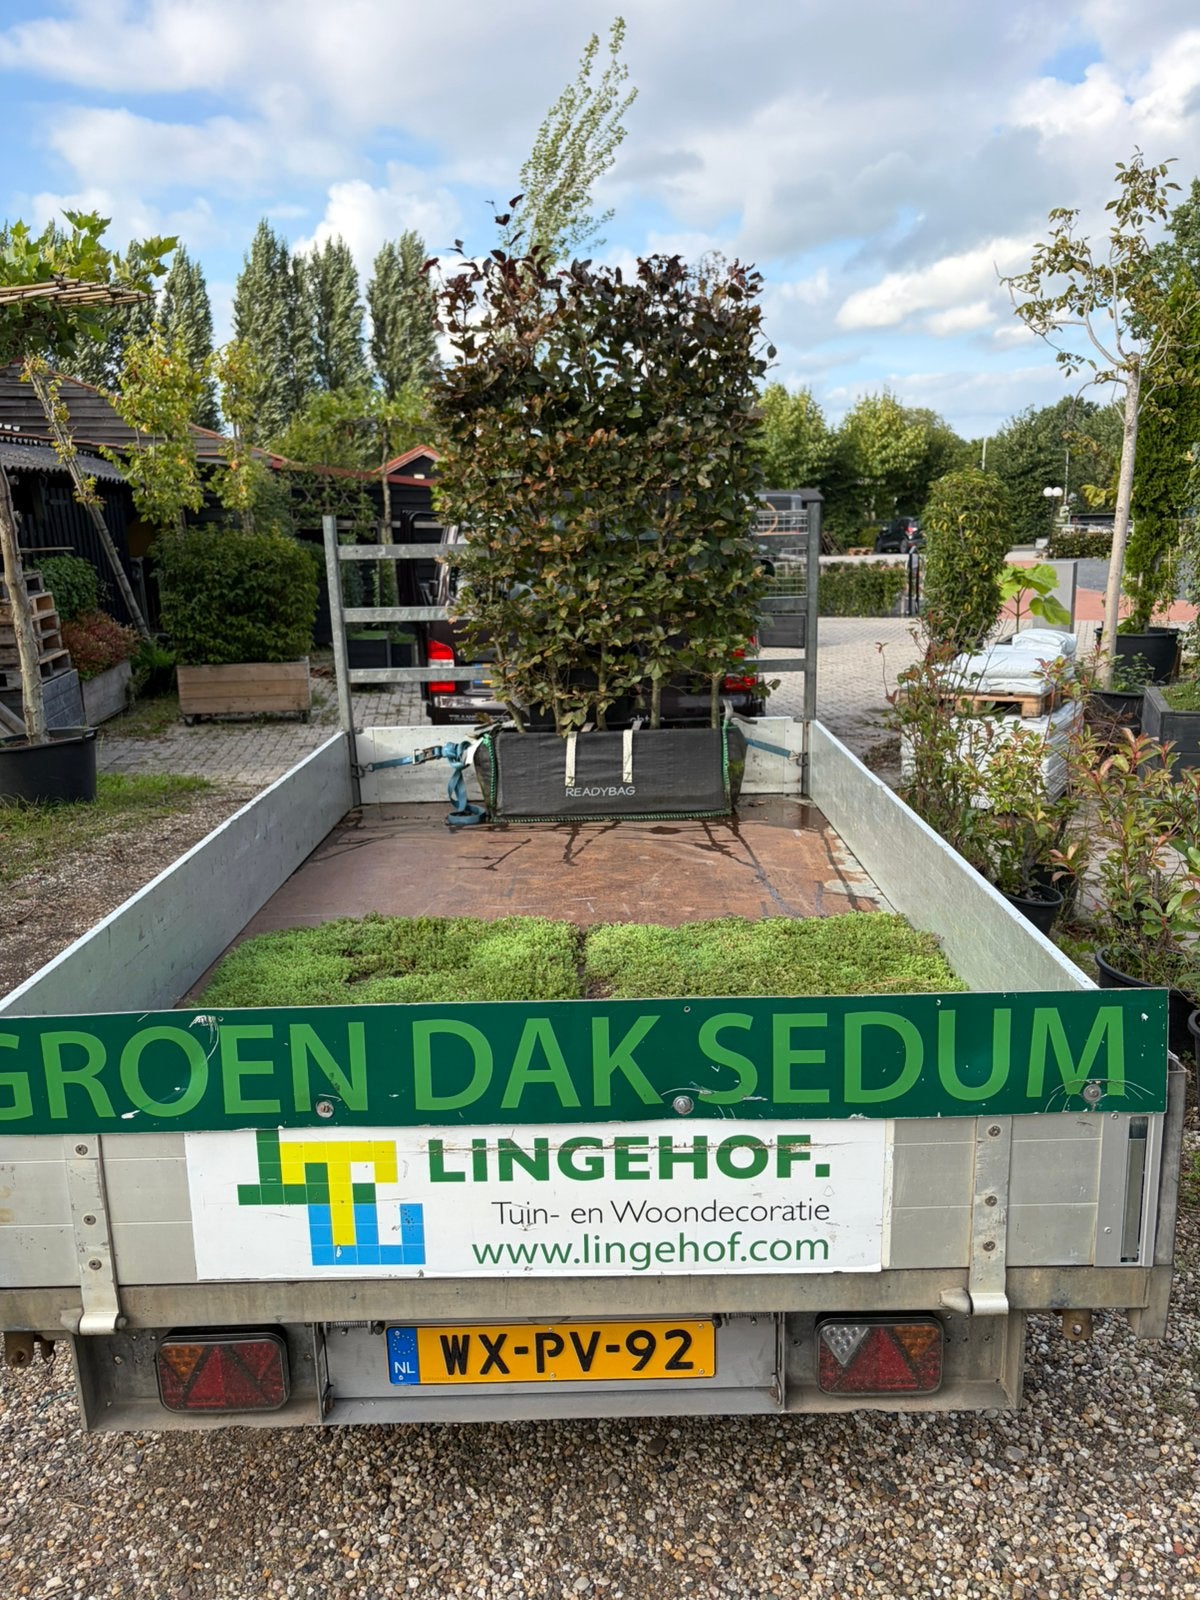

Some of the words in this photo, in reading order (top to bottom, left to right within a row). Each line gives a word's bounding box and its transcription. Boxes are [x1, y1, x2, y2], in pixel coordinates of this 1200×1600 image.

[565, 786, 636, 797] READYBAG
[412, 1015, 665, 1110] DAK
[698, 1005, 1126, 1105] SEDUM
[428, 1134, 831, 1183] LINGEHOF.
[491, 1201, 560, 1225] Tuin-
[570, 1207, 603, 1224] en
[610, 1198, 831, 1224] Woondecoratie
[472, 1231, 830, 1271] www.lingehof.com
[394, 1361, 416, 1374] NL
[439, 1329, 694, 1376] WX-PV-92
